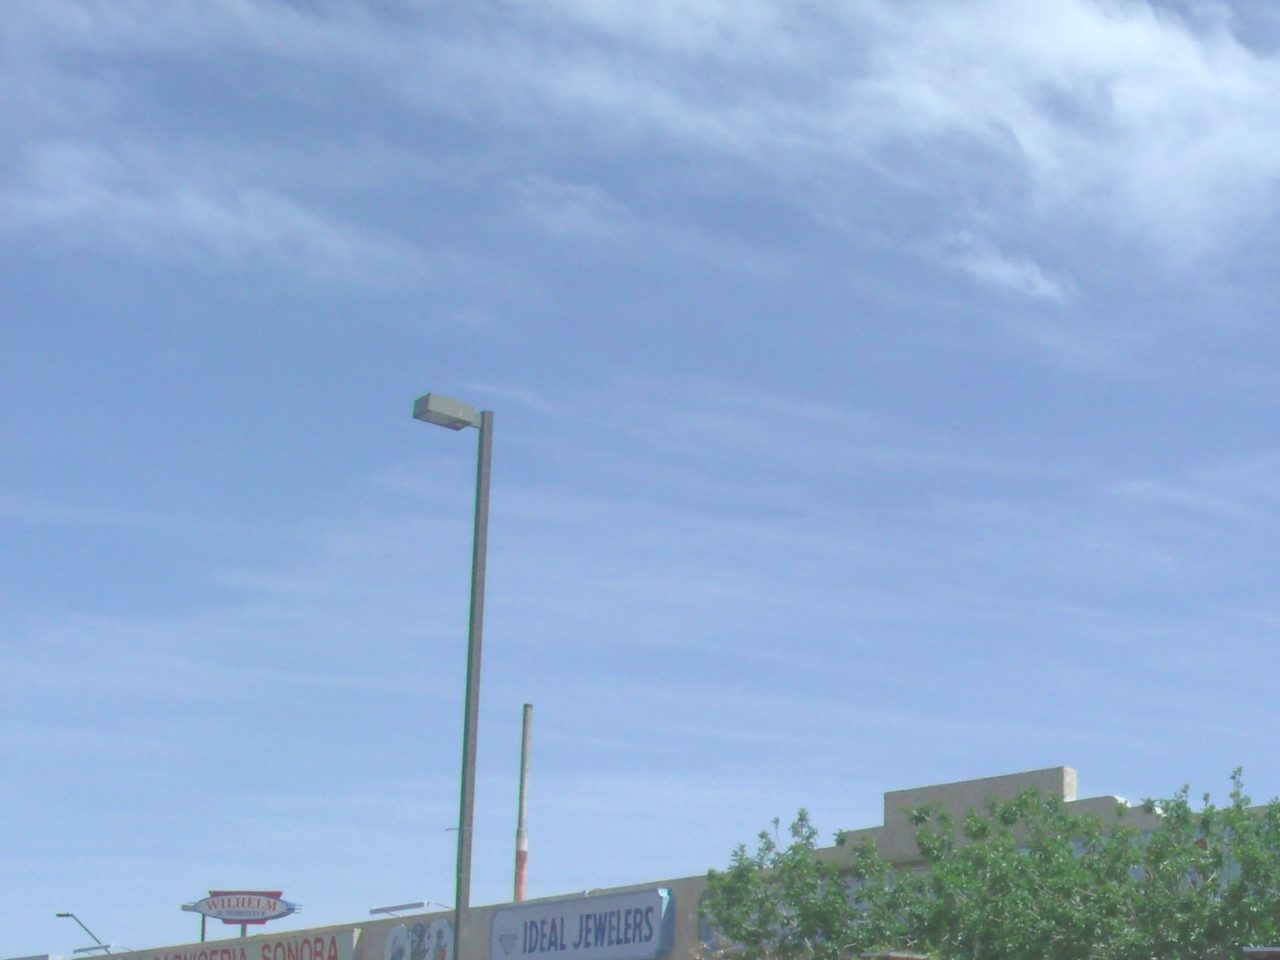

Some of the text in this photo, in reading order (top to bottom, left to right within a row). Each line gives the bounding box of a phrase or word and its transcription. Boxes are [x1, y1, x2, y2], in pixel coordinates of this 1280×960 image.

[206, 897, 278, 912] WILHELM
[523, 906, 655, 954] IDEAL JEWELERS
